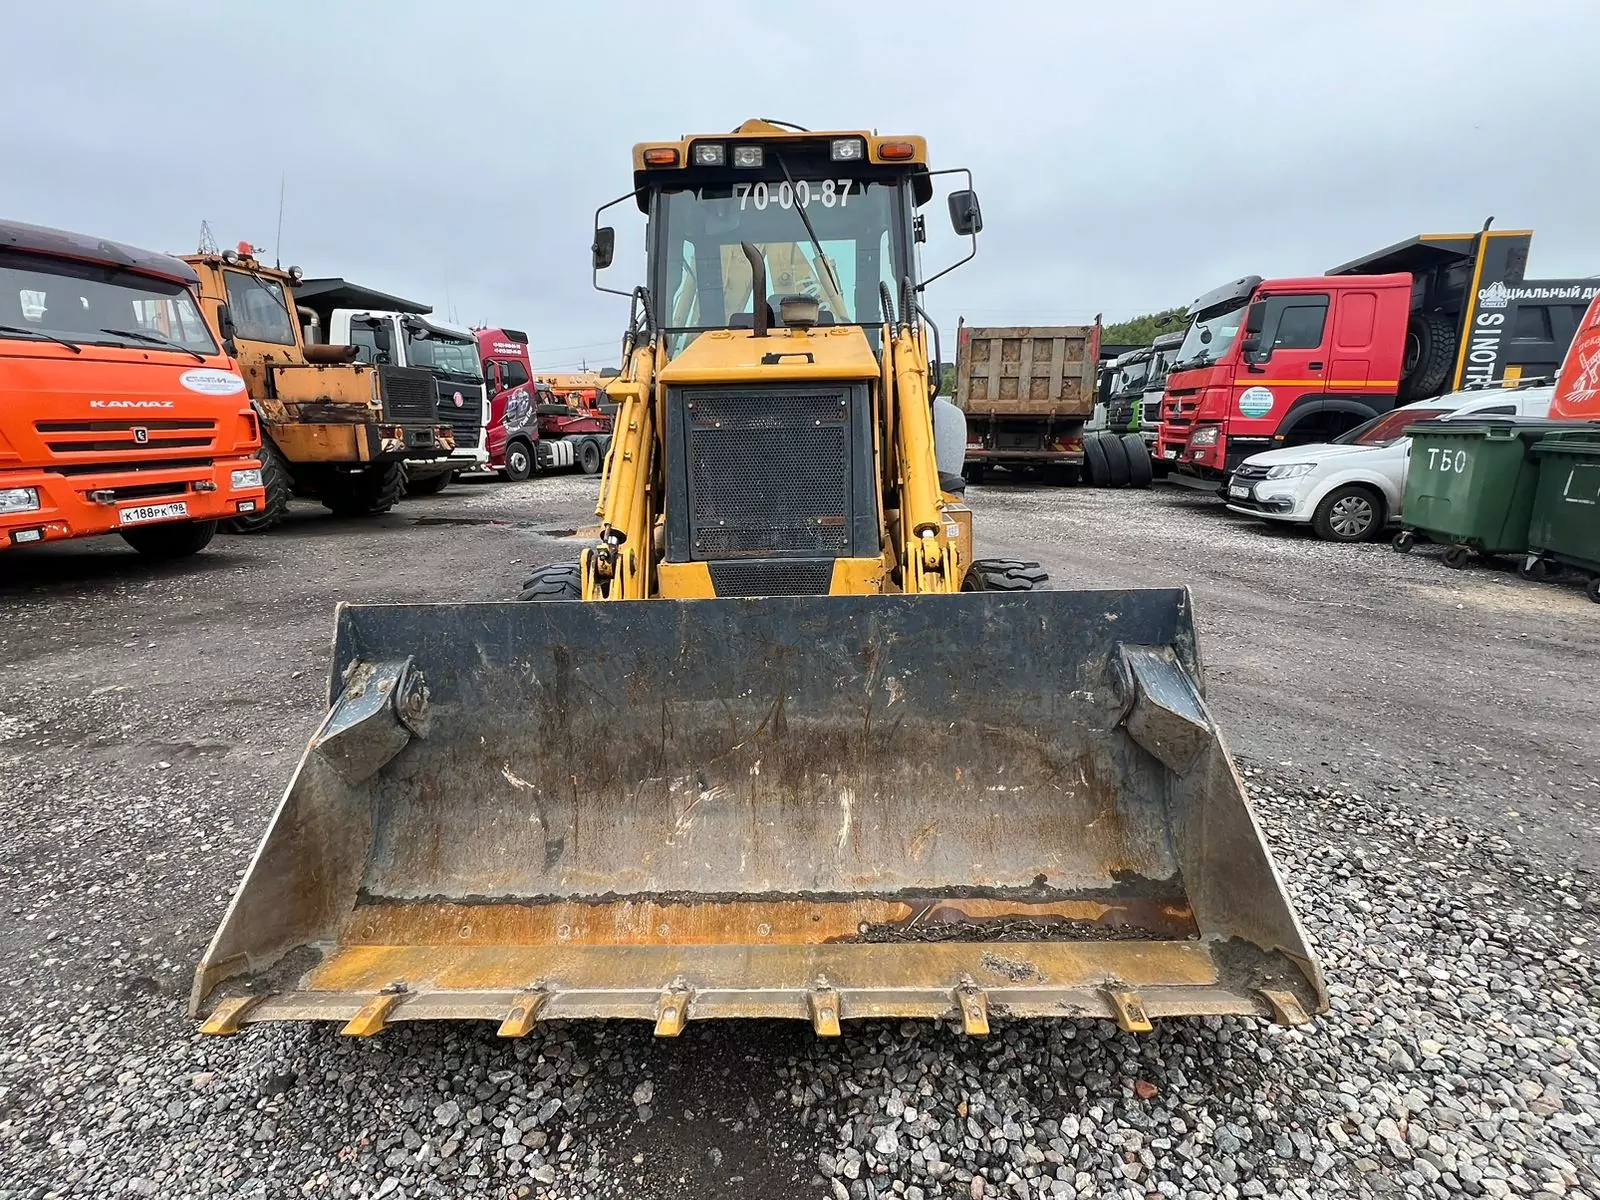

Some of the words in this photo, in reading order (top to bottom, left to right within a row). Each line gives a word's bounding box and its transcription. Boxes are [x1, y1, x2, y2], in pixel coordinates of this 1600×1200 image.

[735, 179, 853, 211] 70-00-87
[1478, 286, 1581, 300] ОЦИАЛЬНЫЙ
[90, 400, 174, 408] KAMAZ
[1428, 448, 1466, 473] ТБО
[169, 504, 184, 512] 198
